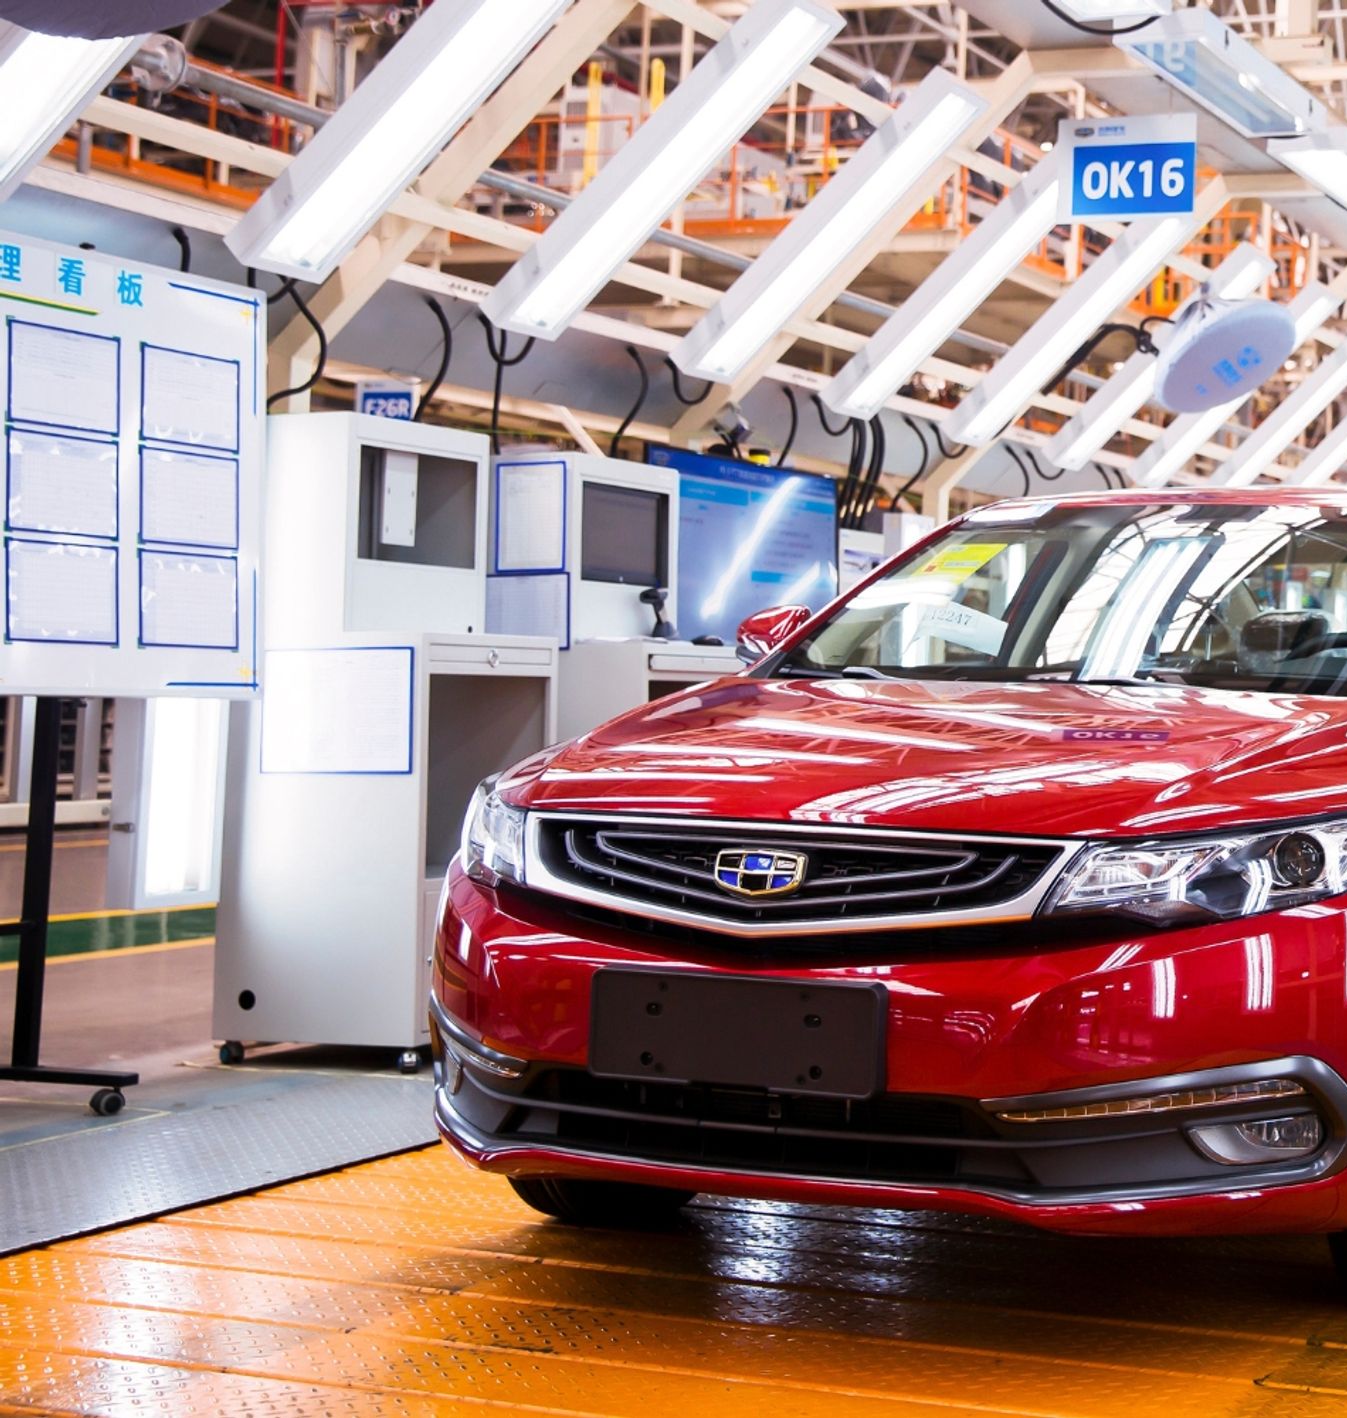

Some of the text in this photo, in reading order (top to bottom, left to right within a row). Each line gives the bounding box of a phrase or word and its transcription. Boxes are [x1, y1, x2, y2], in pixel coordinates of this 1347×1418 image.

[1082, 158, 1185, 200] OK16
[0, 244, 143, 307] 理看板
